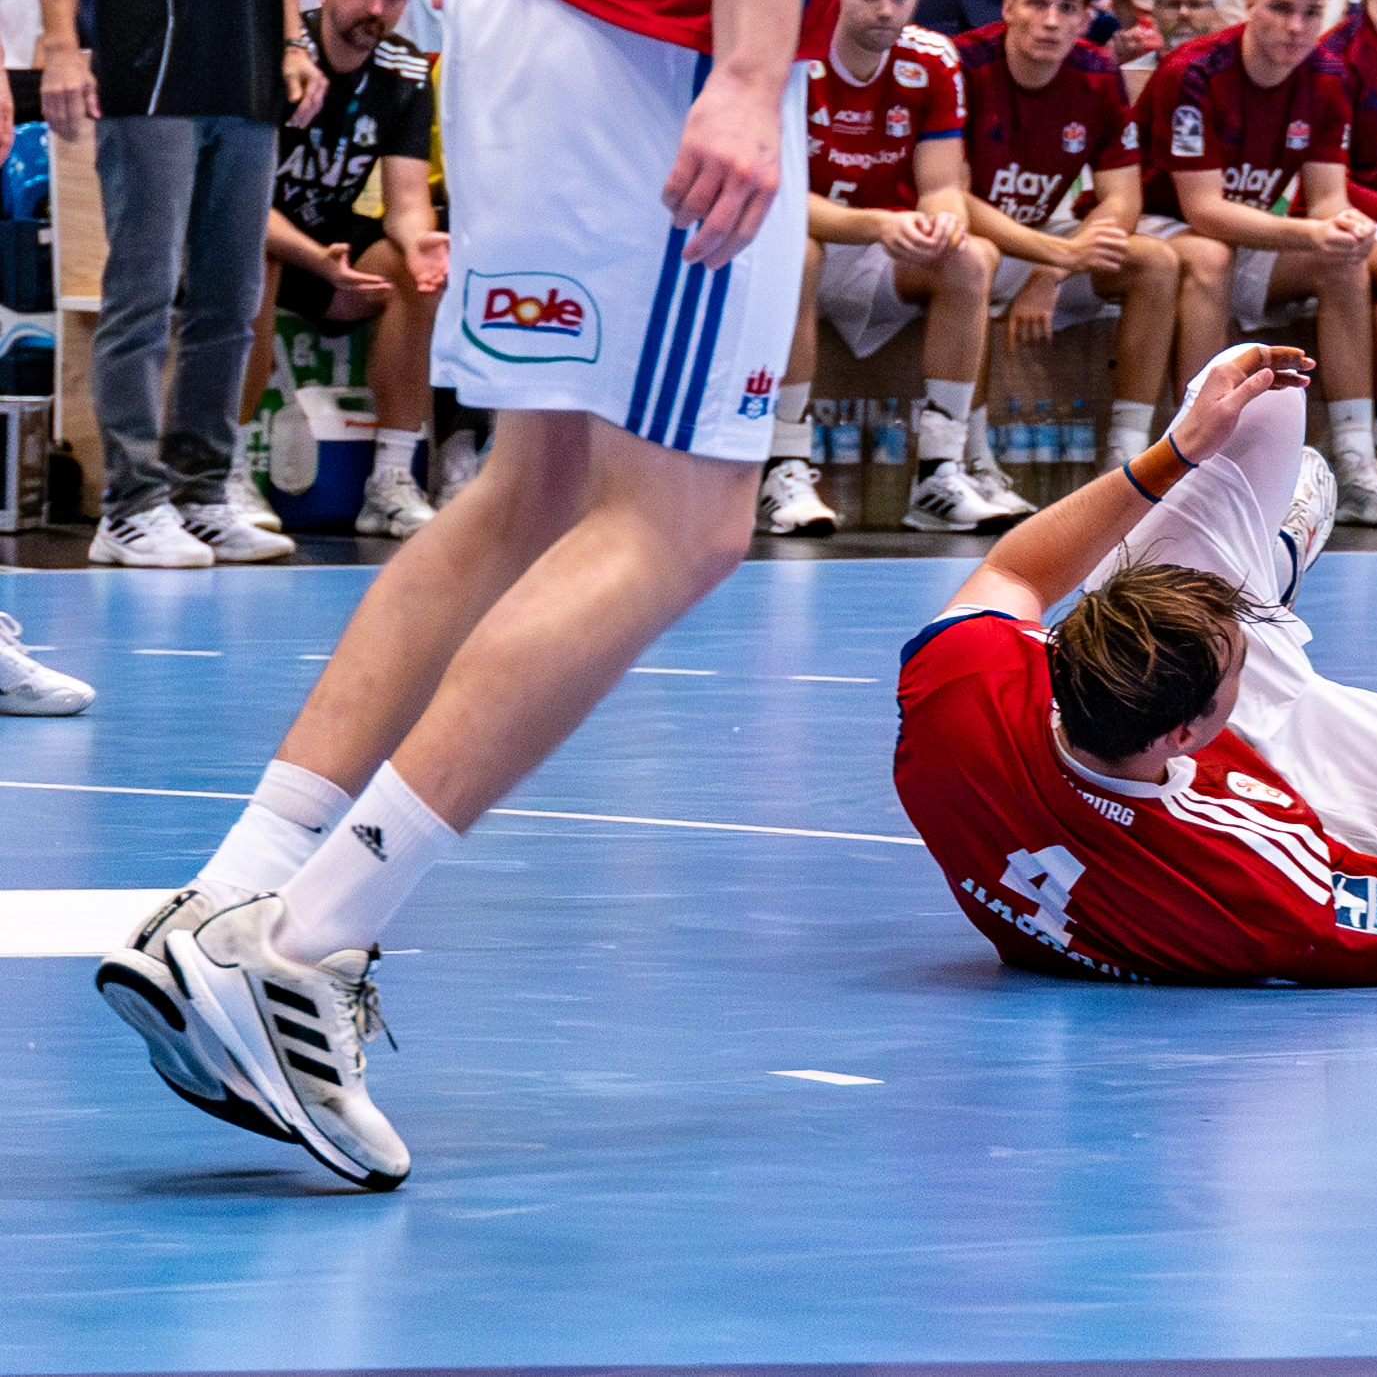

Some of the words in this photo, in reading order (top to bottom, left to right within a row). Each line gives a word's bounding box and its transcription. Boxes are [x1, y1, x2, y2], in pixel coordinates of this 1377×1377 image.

[988, 162, 1062, 204] play
[483, 287, 584, 327] Dole
[999, 845, 1087, 948] 4
